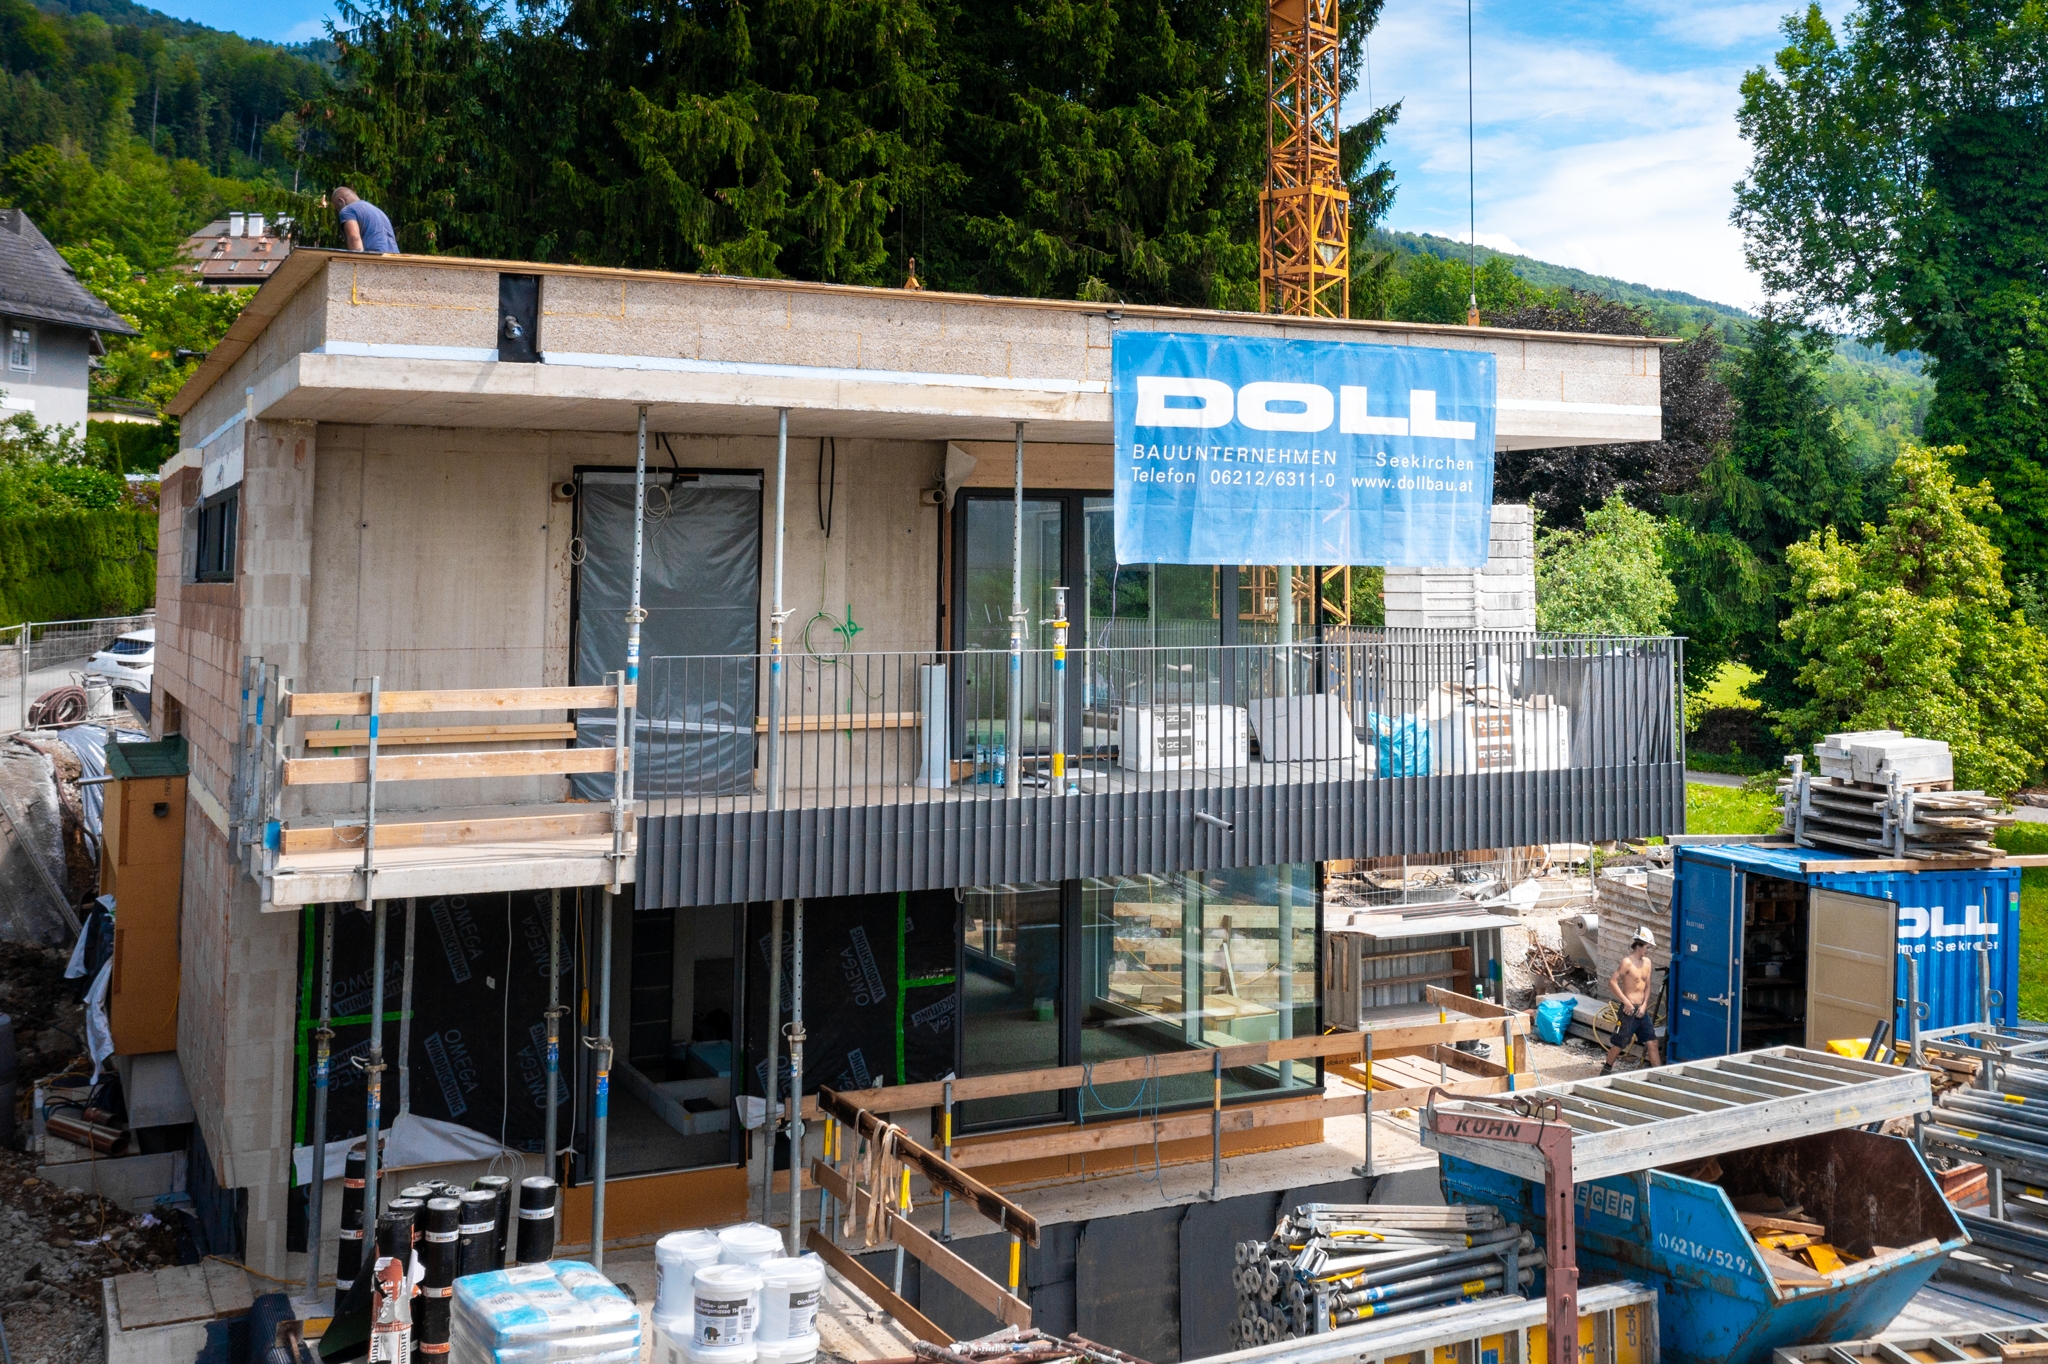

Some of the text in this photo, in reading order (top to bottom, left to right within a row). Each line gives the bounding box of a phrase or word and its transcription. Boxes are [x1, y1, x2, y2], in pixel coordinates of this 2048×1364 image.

[1135, 376, 1476, 440] DOLL
[1131, 467, 1474, 492] Telefon 06212/6311-0 www.dollbau.at
[1132, 444, 1474, 471] BAUUNTERNEHMEN Seekirchen
[450, 896, 484, 961] OMEGA
[840, 946, 870, 1006] OMEGA
[851, 927, 885, 1002] WINDDICHTUNG
[426, 1034, 465, 1113] WINDDICHTUNG
[445, 1029, 479, 1094] OMEGA
[1455, 1119, 1522, 1138] KUHN
[1577, 1184, 1634, 1217] EGER
